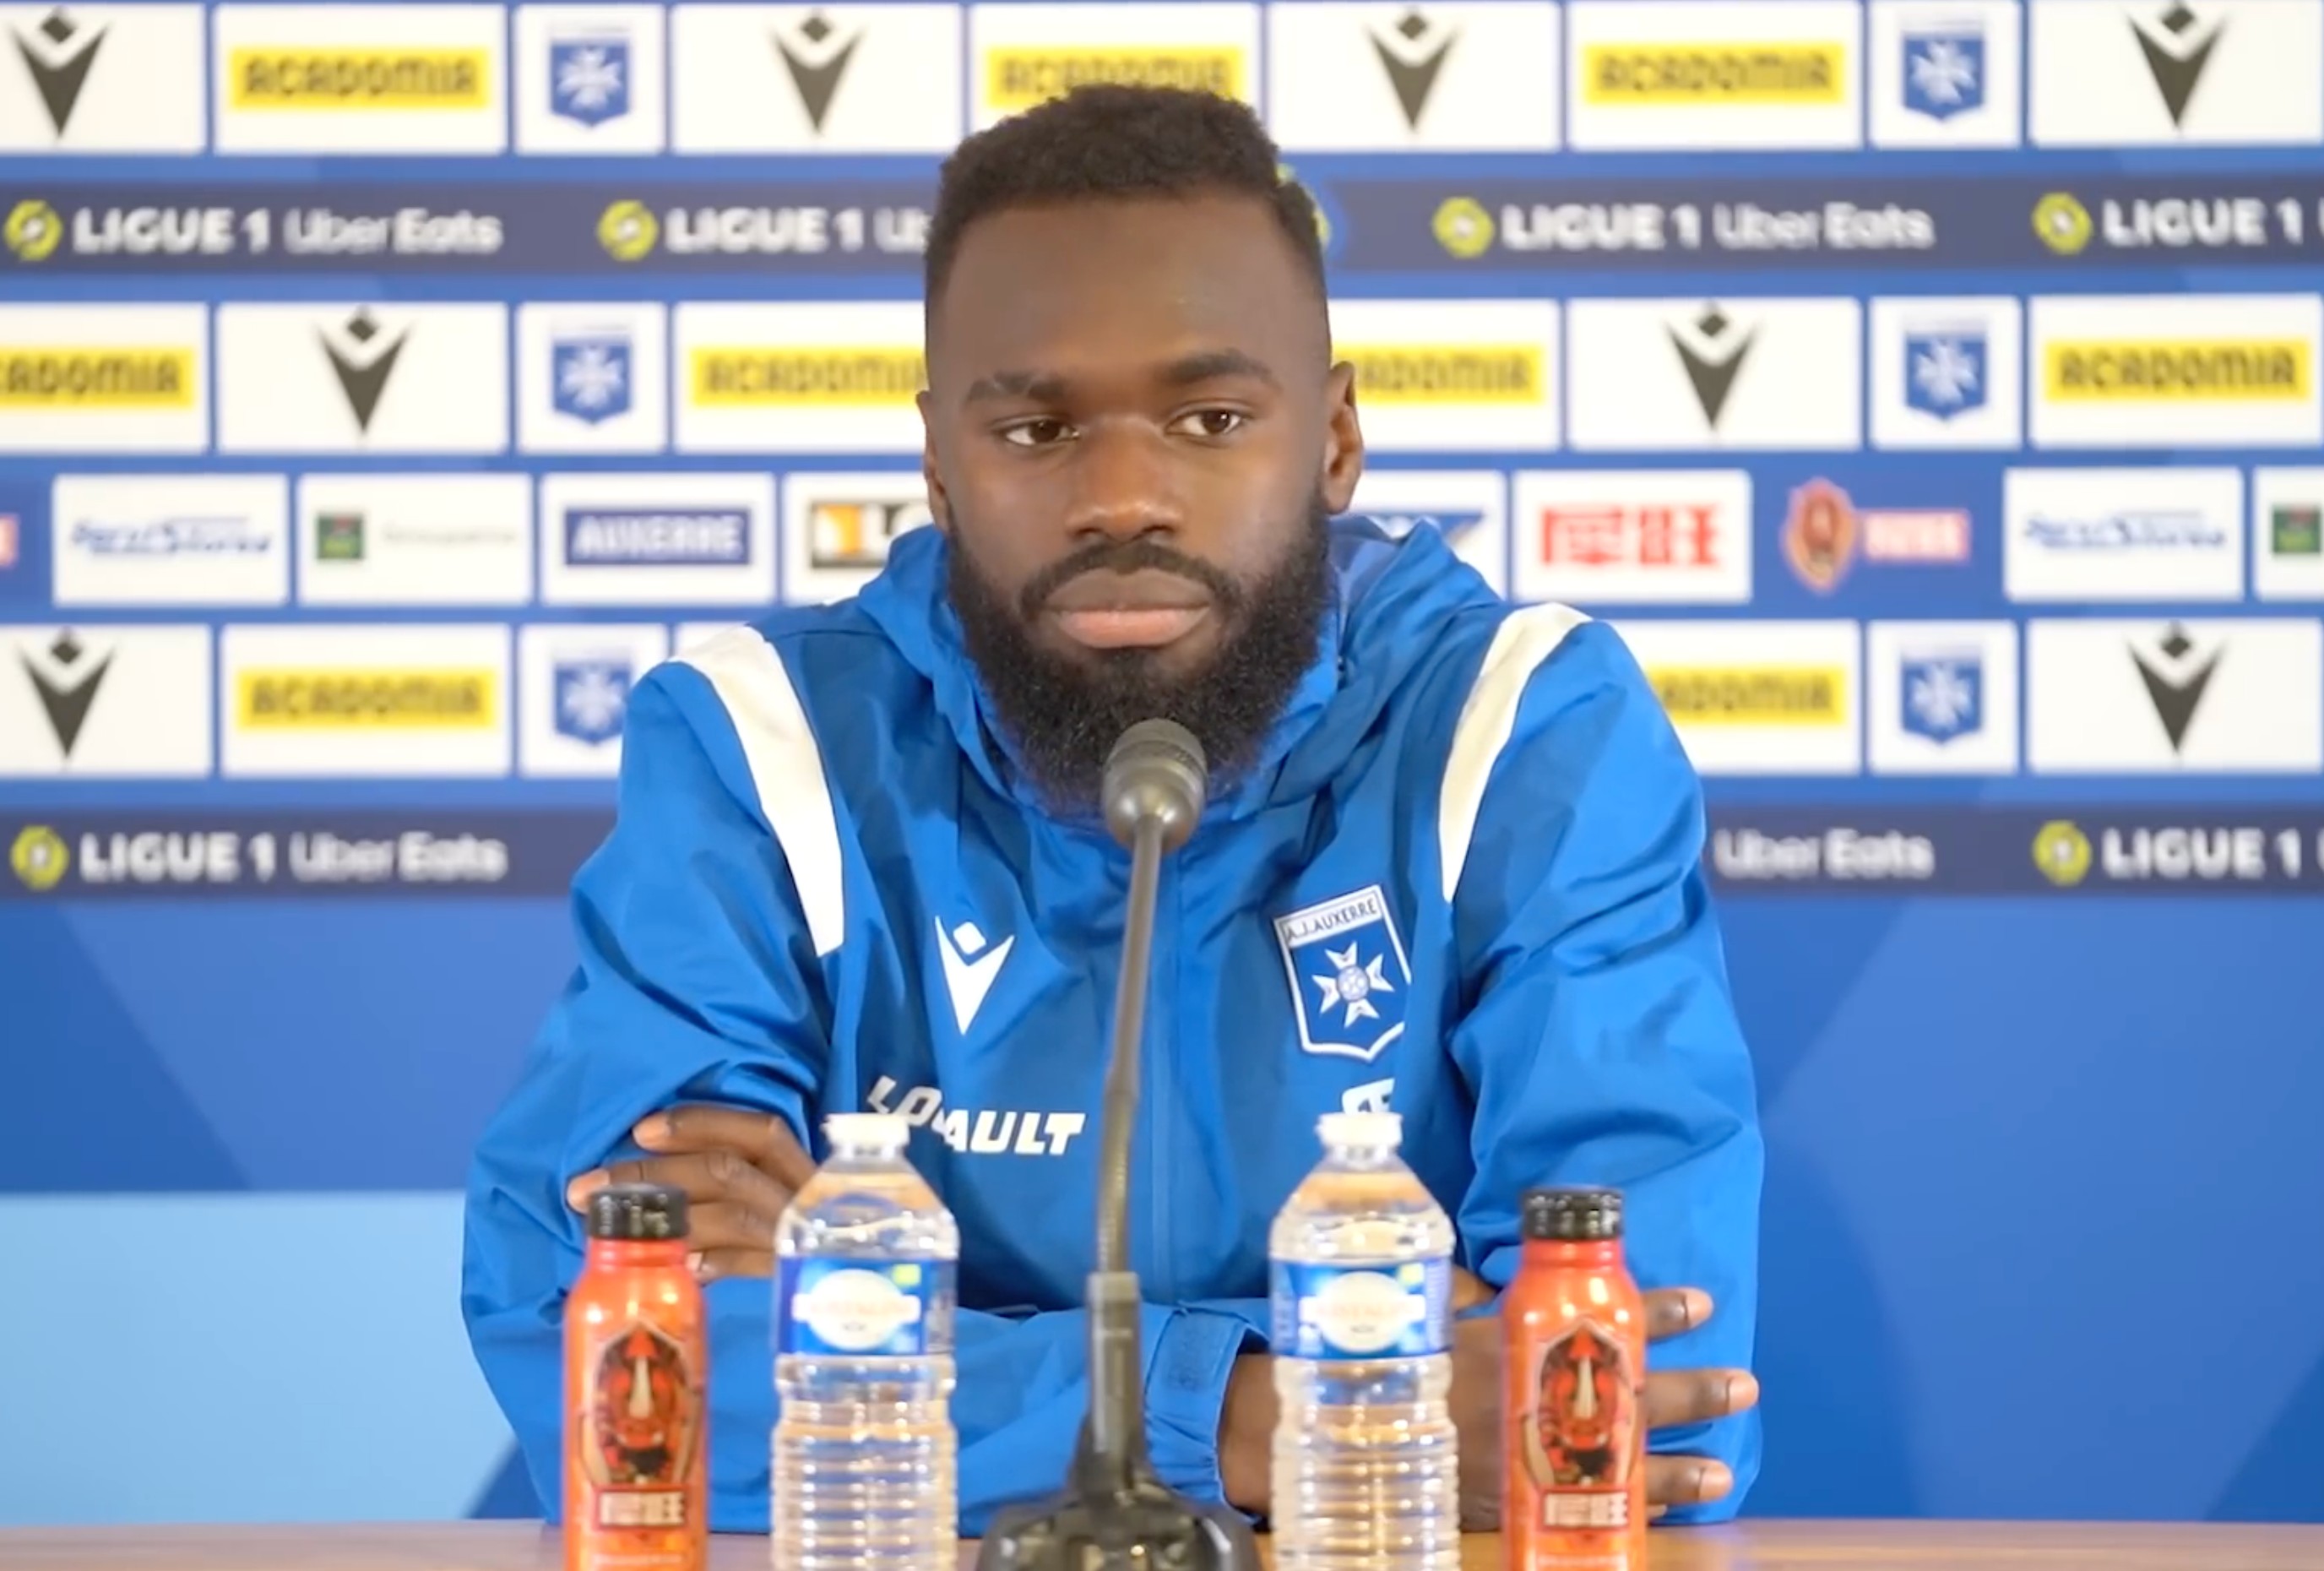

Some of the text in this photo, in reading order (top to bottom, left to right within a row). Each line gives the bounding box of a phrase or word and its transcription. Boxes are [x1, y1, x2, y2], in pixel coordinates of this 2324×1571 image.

[242, 58, 478, 95] ACADOMIA
[1597, 53, 1832, 92] ACADOMIA
[73, 207, 505, 253] LIGUE 1 Uber Eats
[665, 208, 828, 253] LIGUE
[833, 208, 864, 253] 1
[1500, 201, 1936, 250] LIGUE 1 Uber Eats
[2102, 198, 2268, 247] LIGUE
[2276, 197, 2304, 246] 1
[2058, 347, 2298, 391] ACADOMIA
[251, 678, 484, 718] ACADOMIA
[79, 829, 508, 881] LIGUE 1 Uber Eats
[1713, 827, 1936, 879] Uber Eats
[2100, 827, 2267, 879] LIGUE
[2275, 827, 2303, 879] 1
